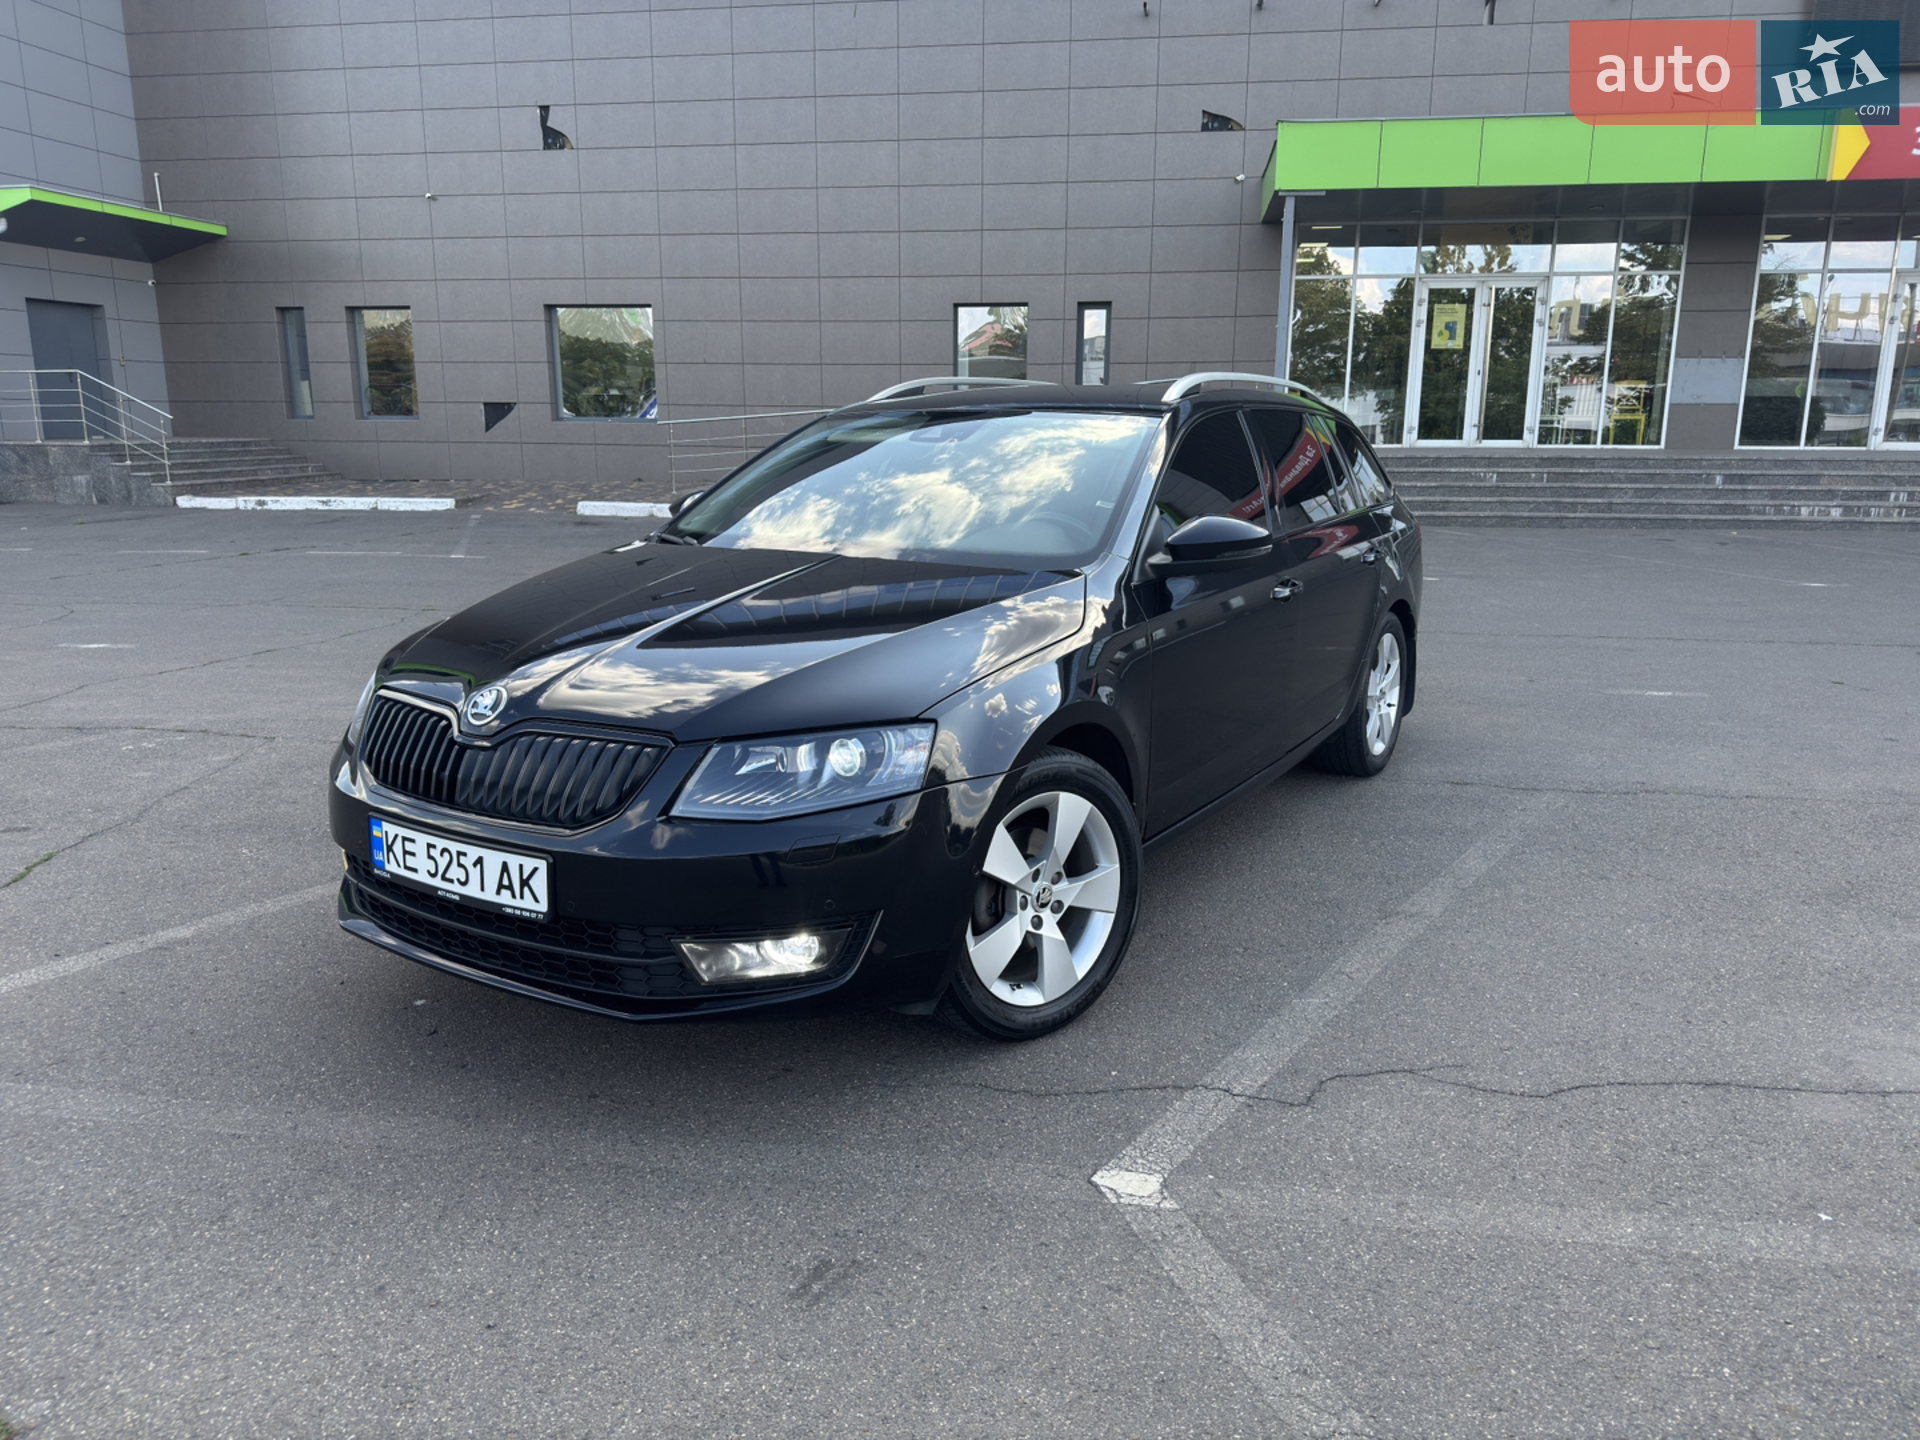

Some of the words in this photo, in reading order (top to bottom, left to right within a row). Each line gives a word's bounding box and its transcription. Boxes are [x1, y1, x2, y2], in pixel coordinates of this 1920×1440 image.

[373, 849, 384, 861] UA
[384, 830, 419, 874] KE
[426, 841, 486, 892] 5251
[495, 860, 541, 904] AK
